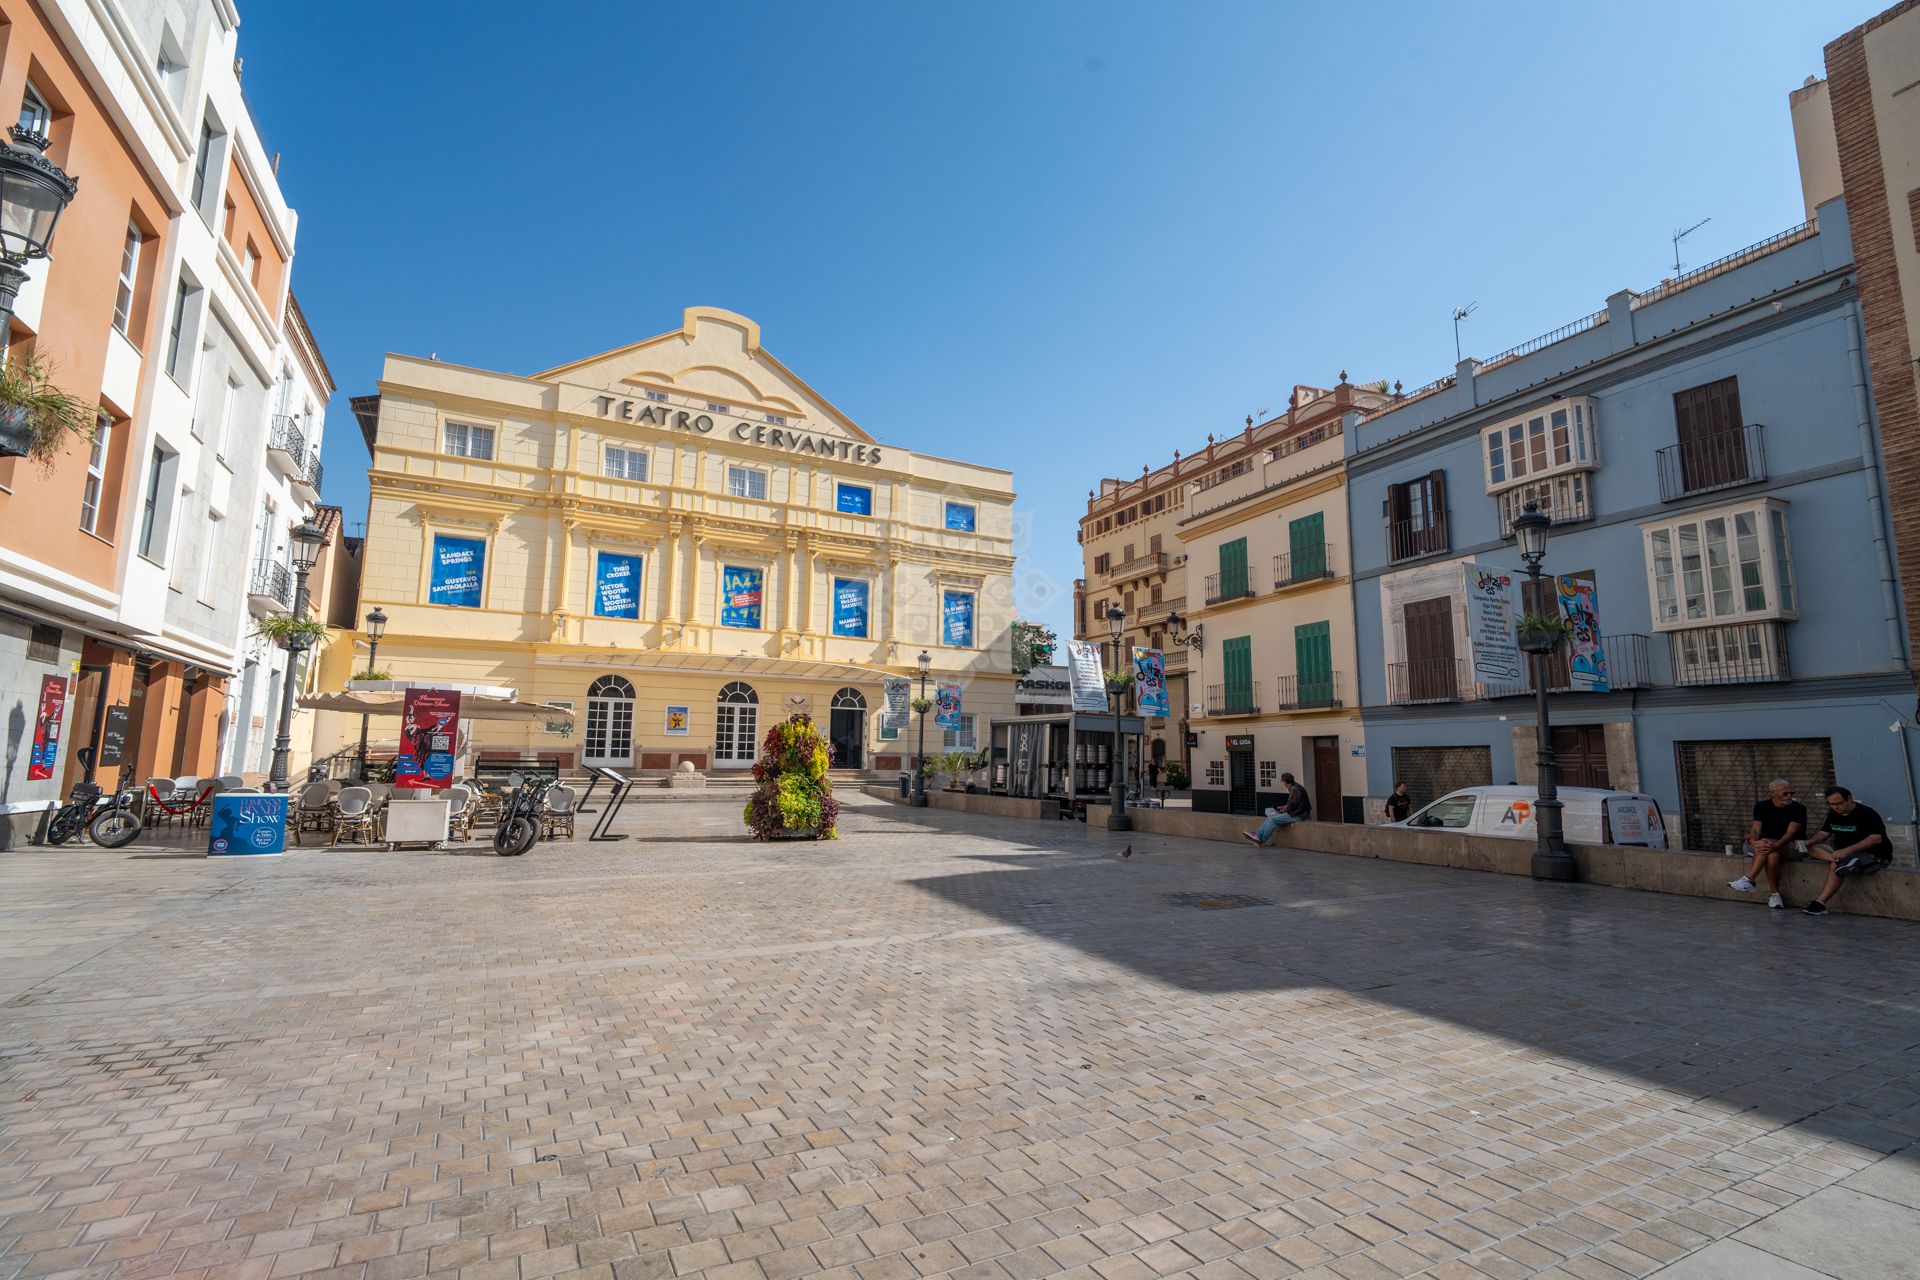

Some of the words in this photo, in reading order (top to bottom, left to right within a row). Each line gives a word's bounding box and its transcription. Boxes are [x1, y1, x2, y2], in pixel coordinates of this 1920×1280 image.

[597, 395, 714, 432] TEATRO
[736, 422, 882, 464] CERVANTES
[441, 551, 474, 559] KANDACE
[442, 557, 472, 565] SPRINGS
[445, 576, 476, 584] GUSTAVO
[725, 573, 762, 590] JAZZ
[433, 582, 478, 592] SANTAOLALLA
[605, 603, 636, 611] BROTHERS
[240, 805, 281, 814] DINNER
[240, 811, 280, 823] Show
